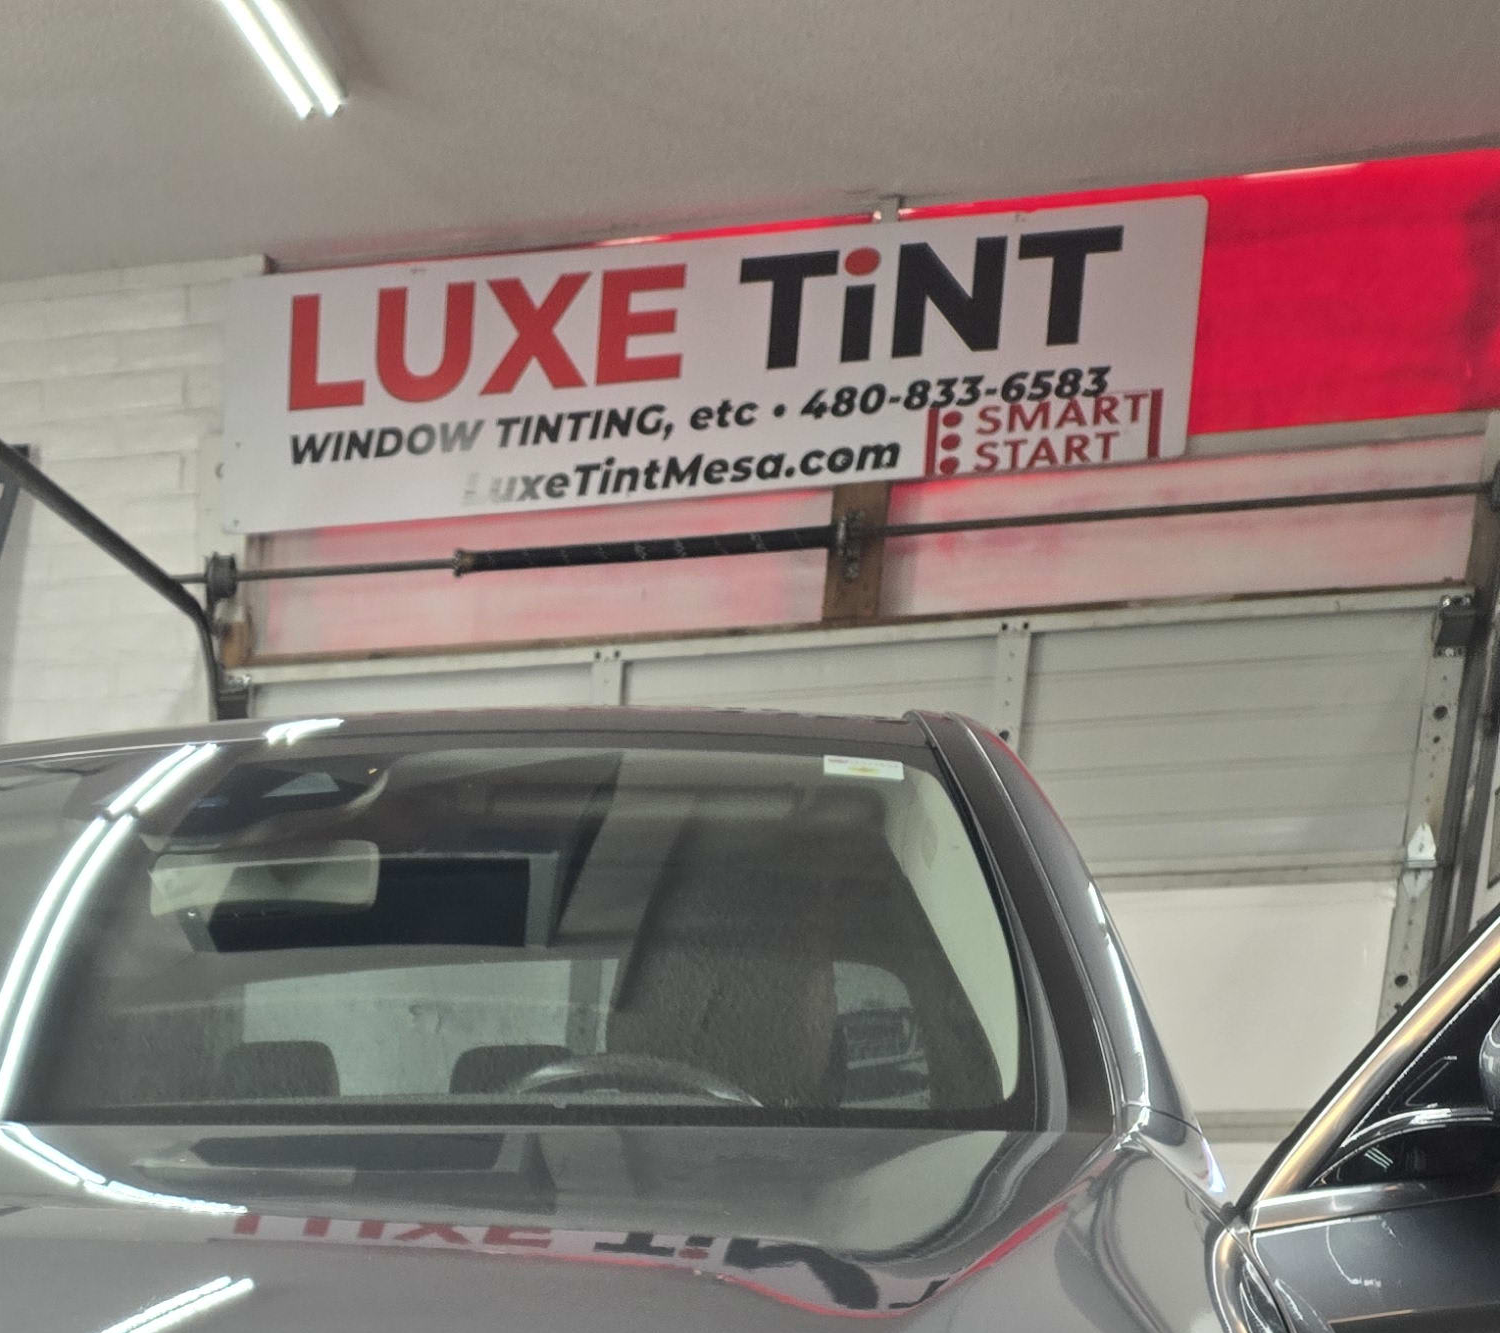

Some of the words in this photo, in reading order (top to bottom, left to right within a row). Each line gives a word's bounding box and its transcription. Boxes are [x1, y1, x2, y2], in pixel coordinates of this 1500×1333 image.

[287, 263, 688, 412] LUXE
[739, 225, 1125, 370] TiNT
[290, 418, 485, 466] WINDOW
[496, 403, 675, 448] TINTING,
[689, 398, 758, 430] etc
[800, 365, 1112, 420] 480-833-6583
[975, 392, 1150, 436] SMART
[973, 431, 1121, 474] START
